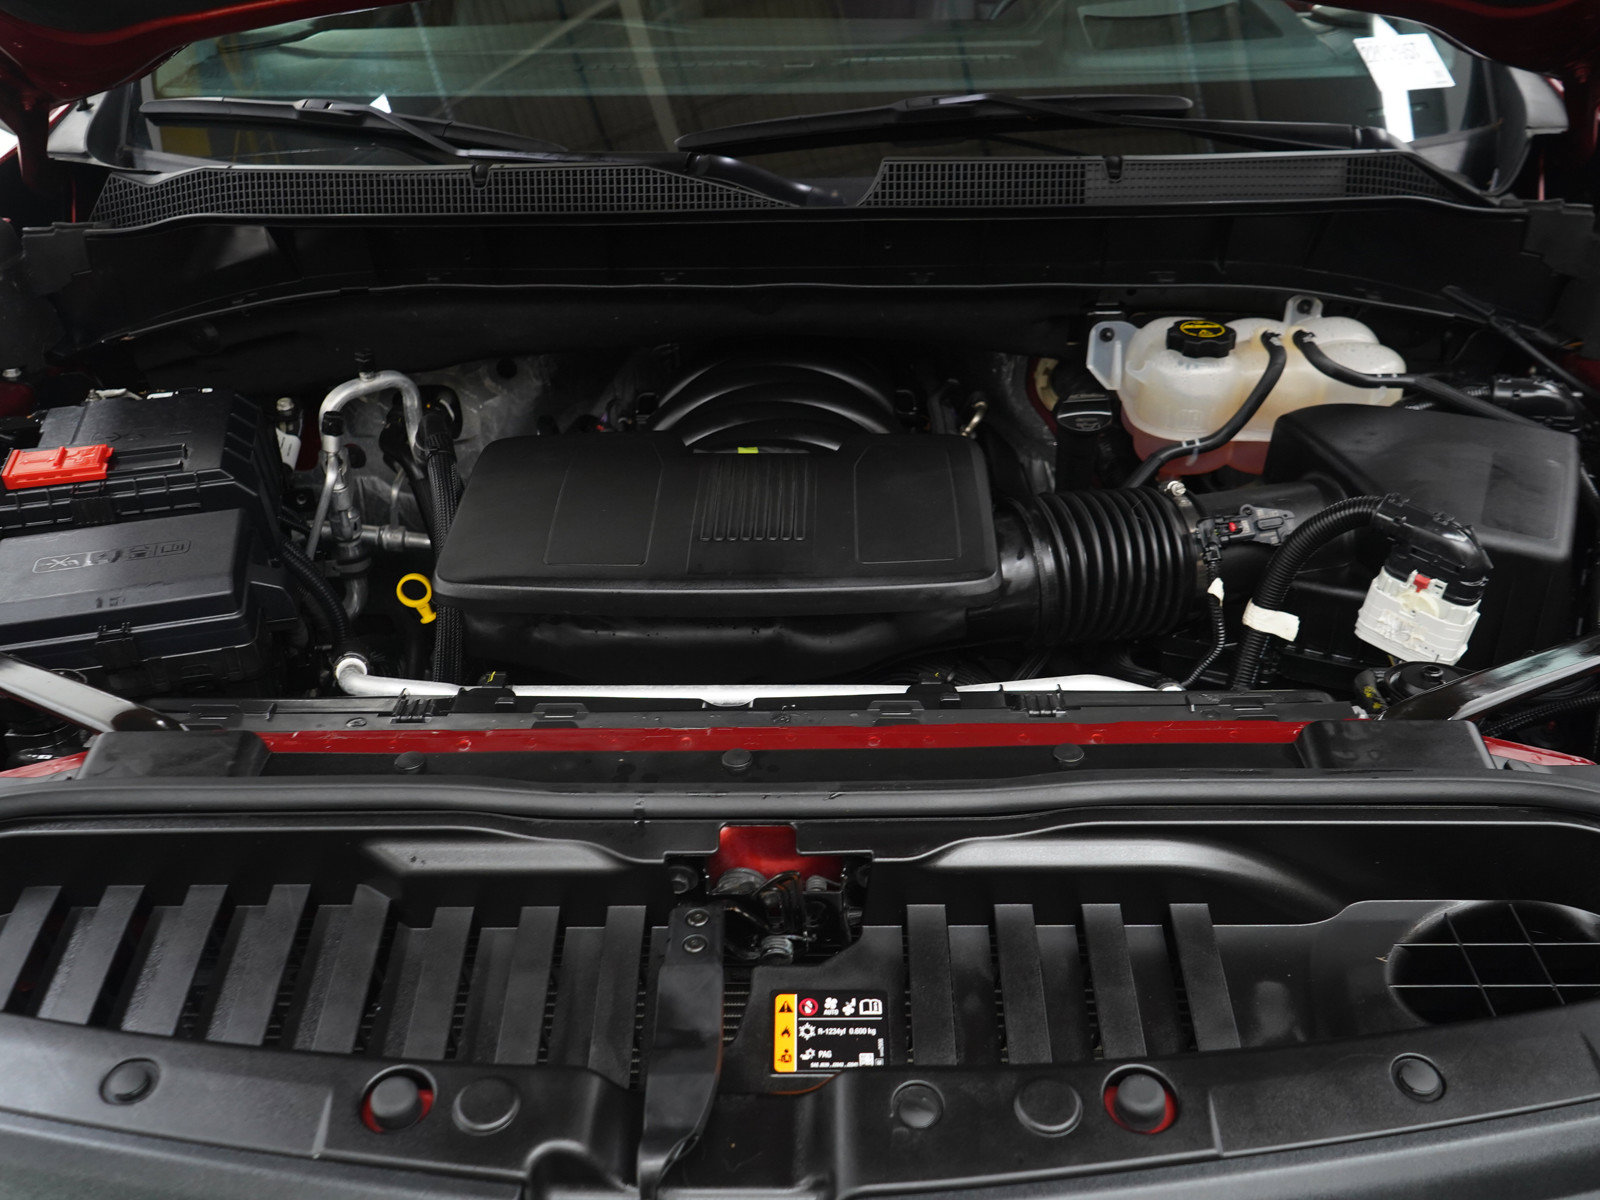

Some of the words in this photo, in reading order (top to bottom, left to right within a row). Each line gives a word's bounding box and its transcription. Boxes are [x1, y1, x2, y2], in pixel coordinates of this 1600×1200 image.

[817, 1027, 847, 1036] R-1234yf
[867, 1027, 877, 1036] kg
[818, 1050, 832, 1058] PAG
